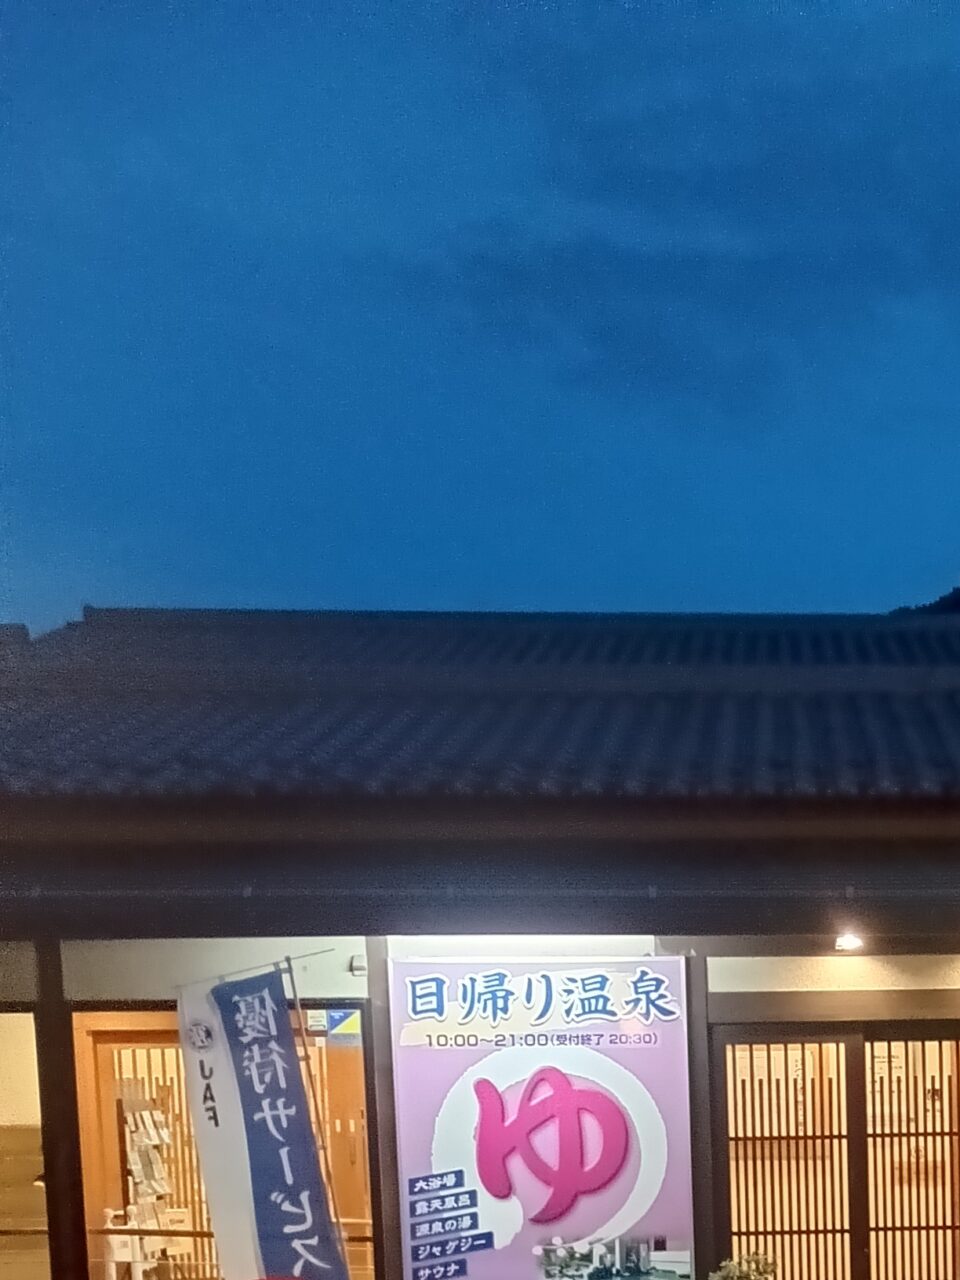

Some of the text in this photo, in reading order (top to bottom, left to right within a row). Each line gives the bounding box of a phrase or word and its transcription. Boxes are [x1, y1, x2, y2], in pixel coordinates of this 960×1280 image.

[408, 968, 681, 1026] 日帰り温泉
[473, 1064, 630, 1226] ゆ
[412, 1172, 457, 1193] 大浴場
[414, 1193, 471, 1216] 露天風呂
